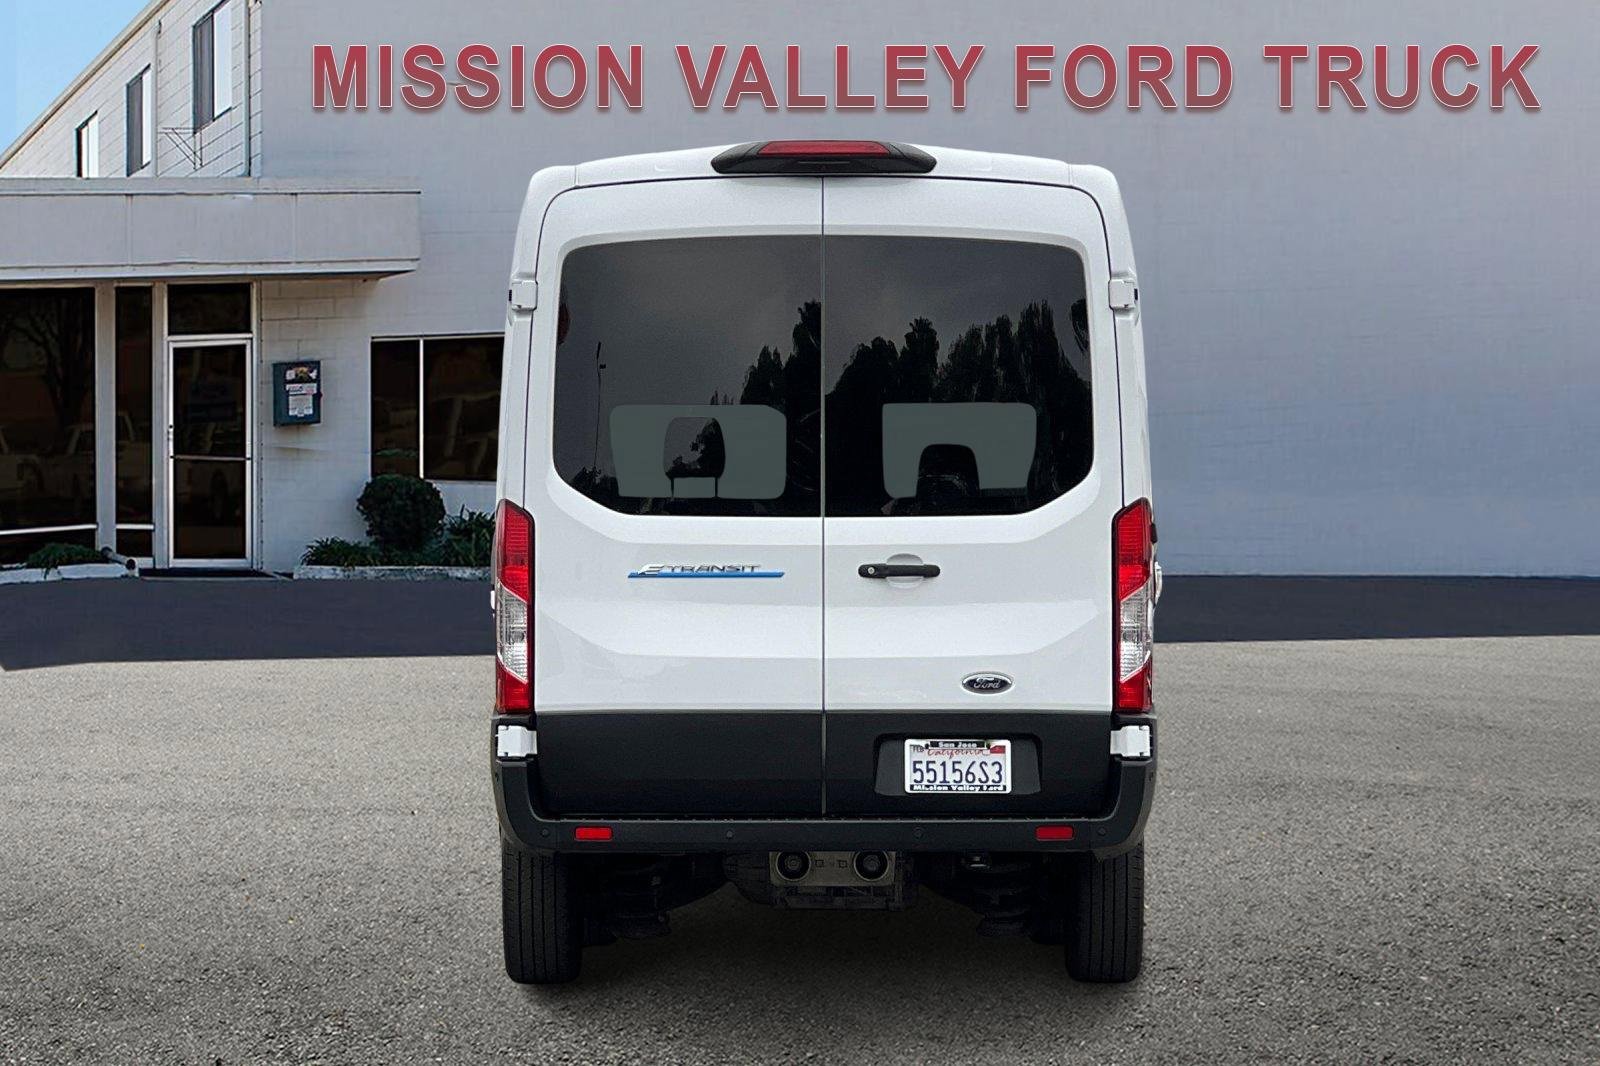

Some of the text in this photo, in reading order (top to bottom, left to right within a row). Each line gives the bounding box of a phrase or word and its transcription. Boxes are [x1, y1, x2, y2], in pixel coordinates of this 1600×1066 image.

[313, 44, 1541, 109] MISSION VALLEY FORD TRUCK
[912, 760, 1003, 784] 55156S3
